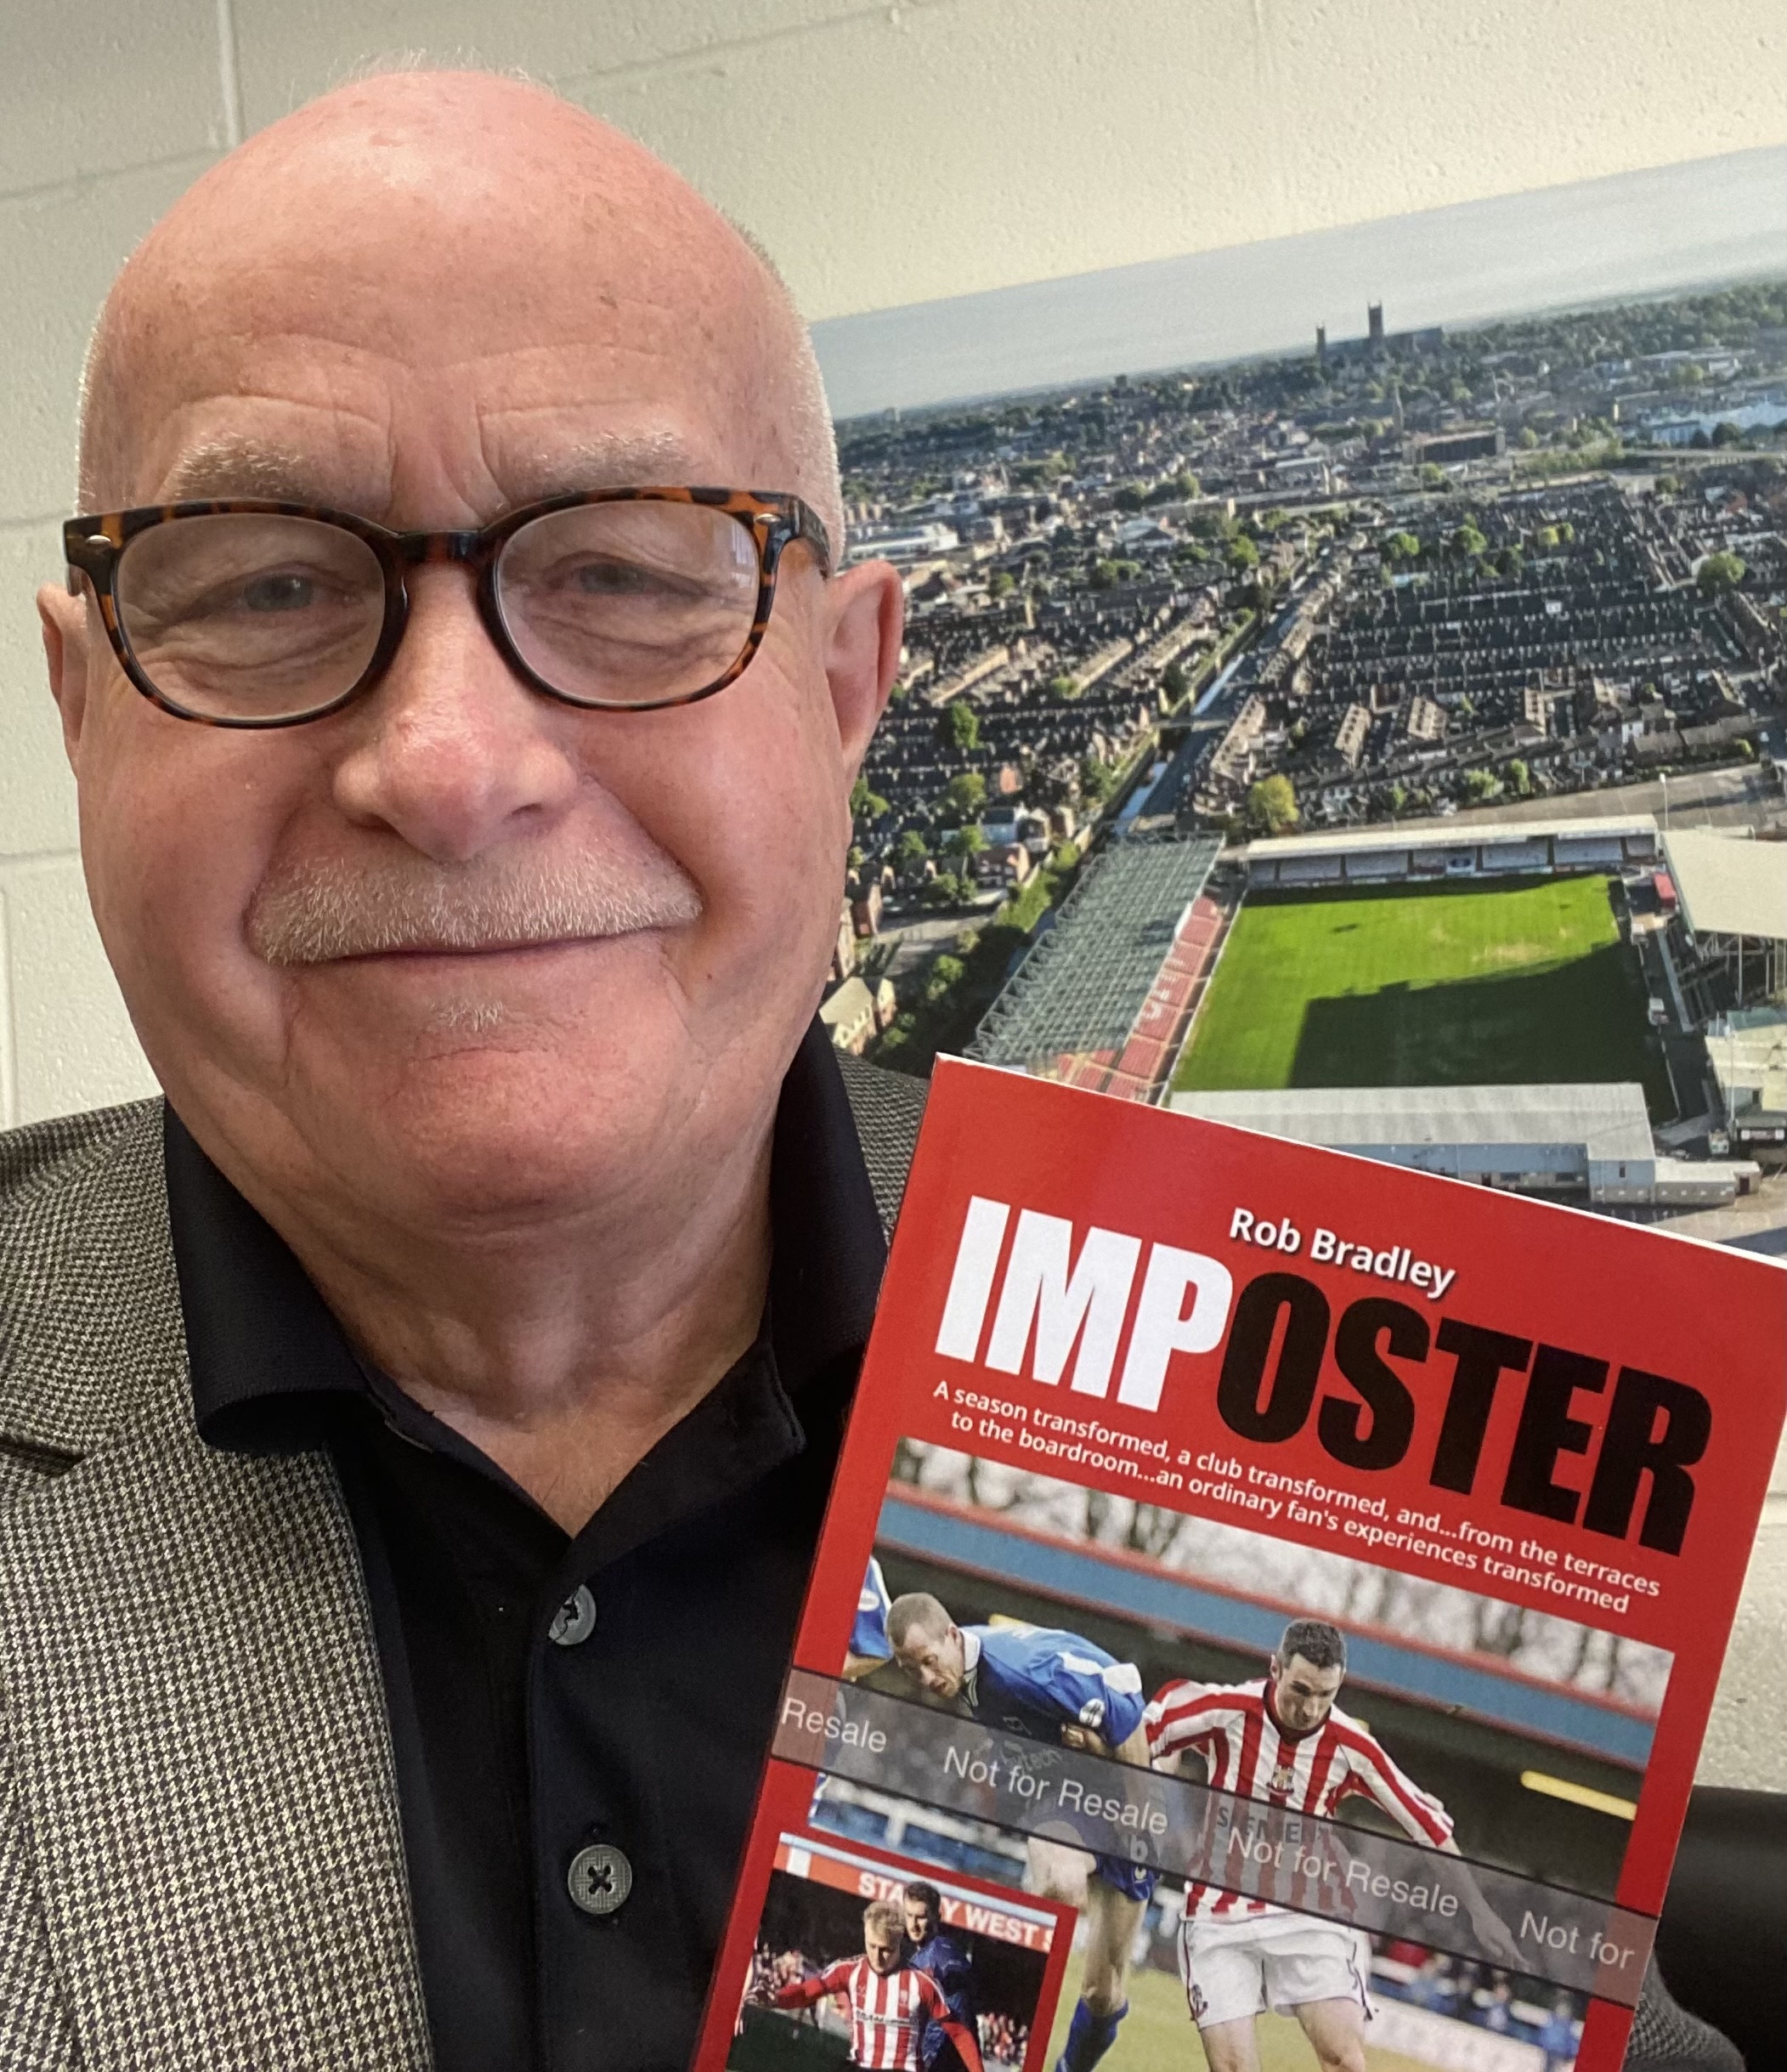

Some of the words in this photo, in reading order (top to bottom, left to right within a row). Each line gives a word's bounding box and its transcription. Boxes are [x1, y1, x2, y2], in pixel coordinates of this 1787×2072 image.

[1229, 1207, 1301, 1253] Rob
[1309, 1227, 1456, 1299] Bradley
[934, 1195, 1711, 1557] IMPOSTER
[933, 1380, 949, 1401] A
[953, 1389, 1028, 1422] season
[1032, 1407, 1170, 1463] transformed,
[1177, 1450, 1191, 1466] a
[1196, 1452, 1242, 1479] club
[1248, 1465, 1389, 1522] transformed,
[1520, 1540, 1558, 1565] the
[1564, 1553, 1660, 1596] terraces
[952, 1411, 973, 1431] to
[979, 1418, 1014, 1443] the
[1188, 1478, 1283, 1520] ordinary
[1287, 1499, 1338, 1531] fan's
[1343, 1520, 1478, 1569] experiences
[1484, 1556, 1630, 1614] transformed
[779, 1696, 888, 1753] Resale
[942, 1746, 998, 1788] Not
[1008, 1765, 1051, 1801] for
[1058, 1778, 1168, 1835] Resale
[1227, 1826, 1285, 1870] Not
[1294, 1844, 1337, 1882] for
[1345, 1859, 1460, 1918] Resale
[1519, 1911, 1580, 1955] Not
[1589, 1931, 1636, 1970] for
[858, 1870, 961, 1922] STAY
[964, 1902, 1040, 1949] WEST
